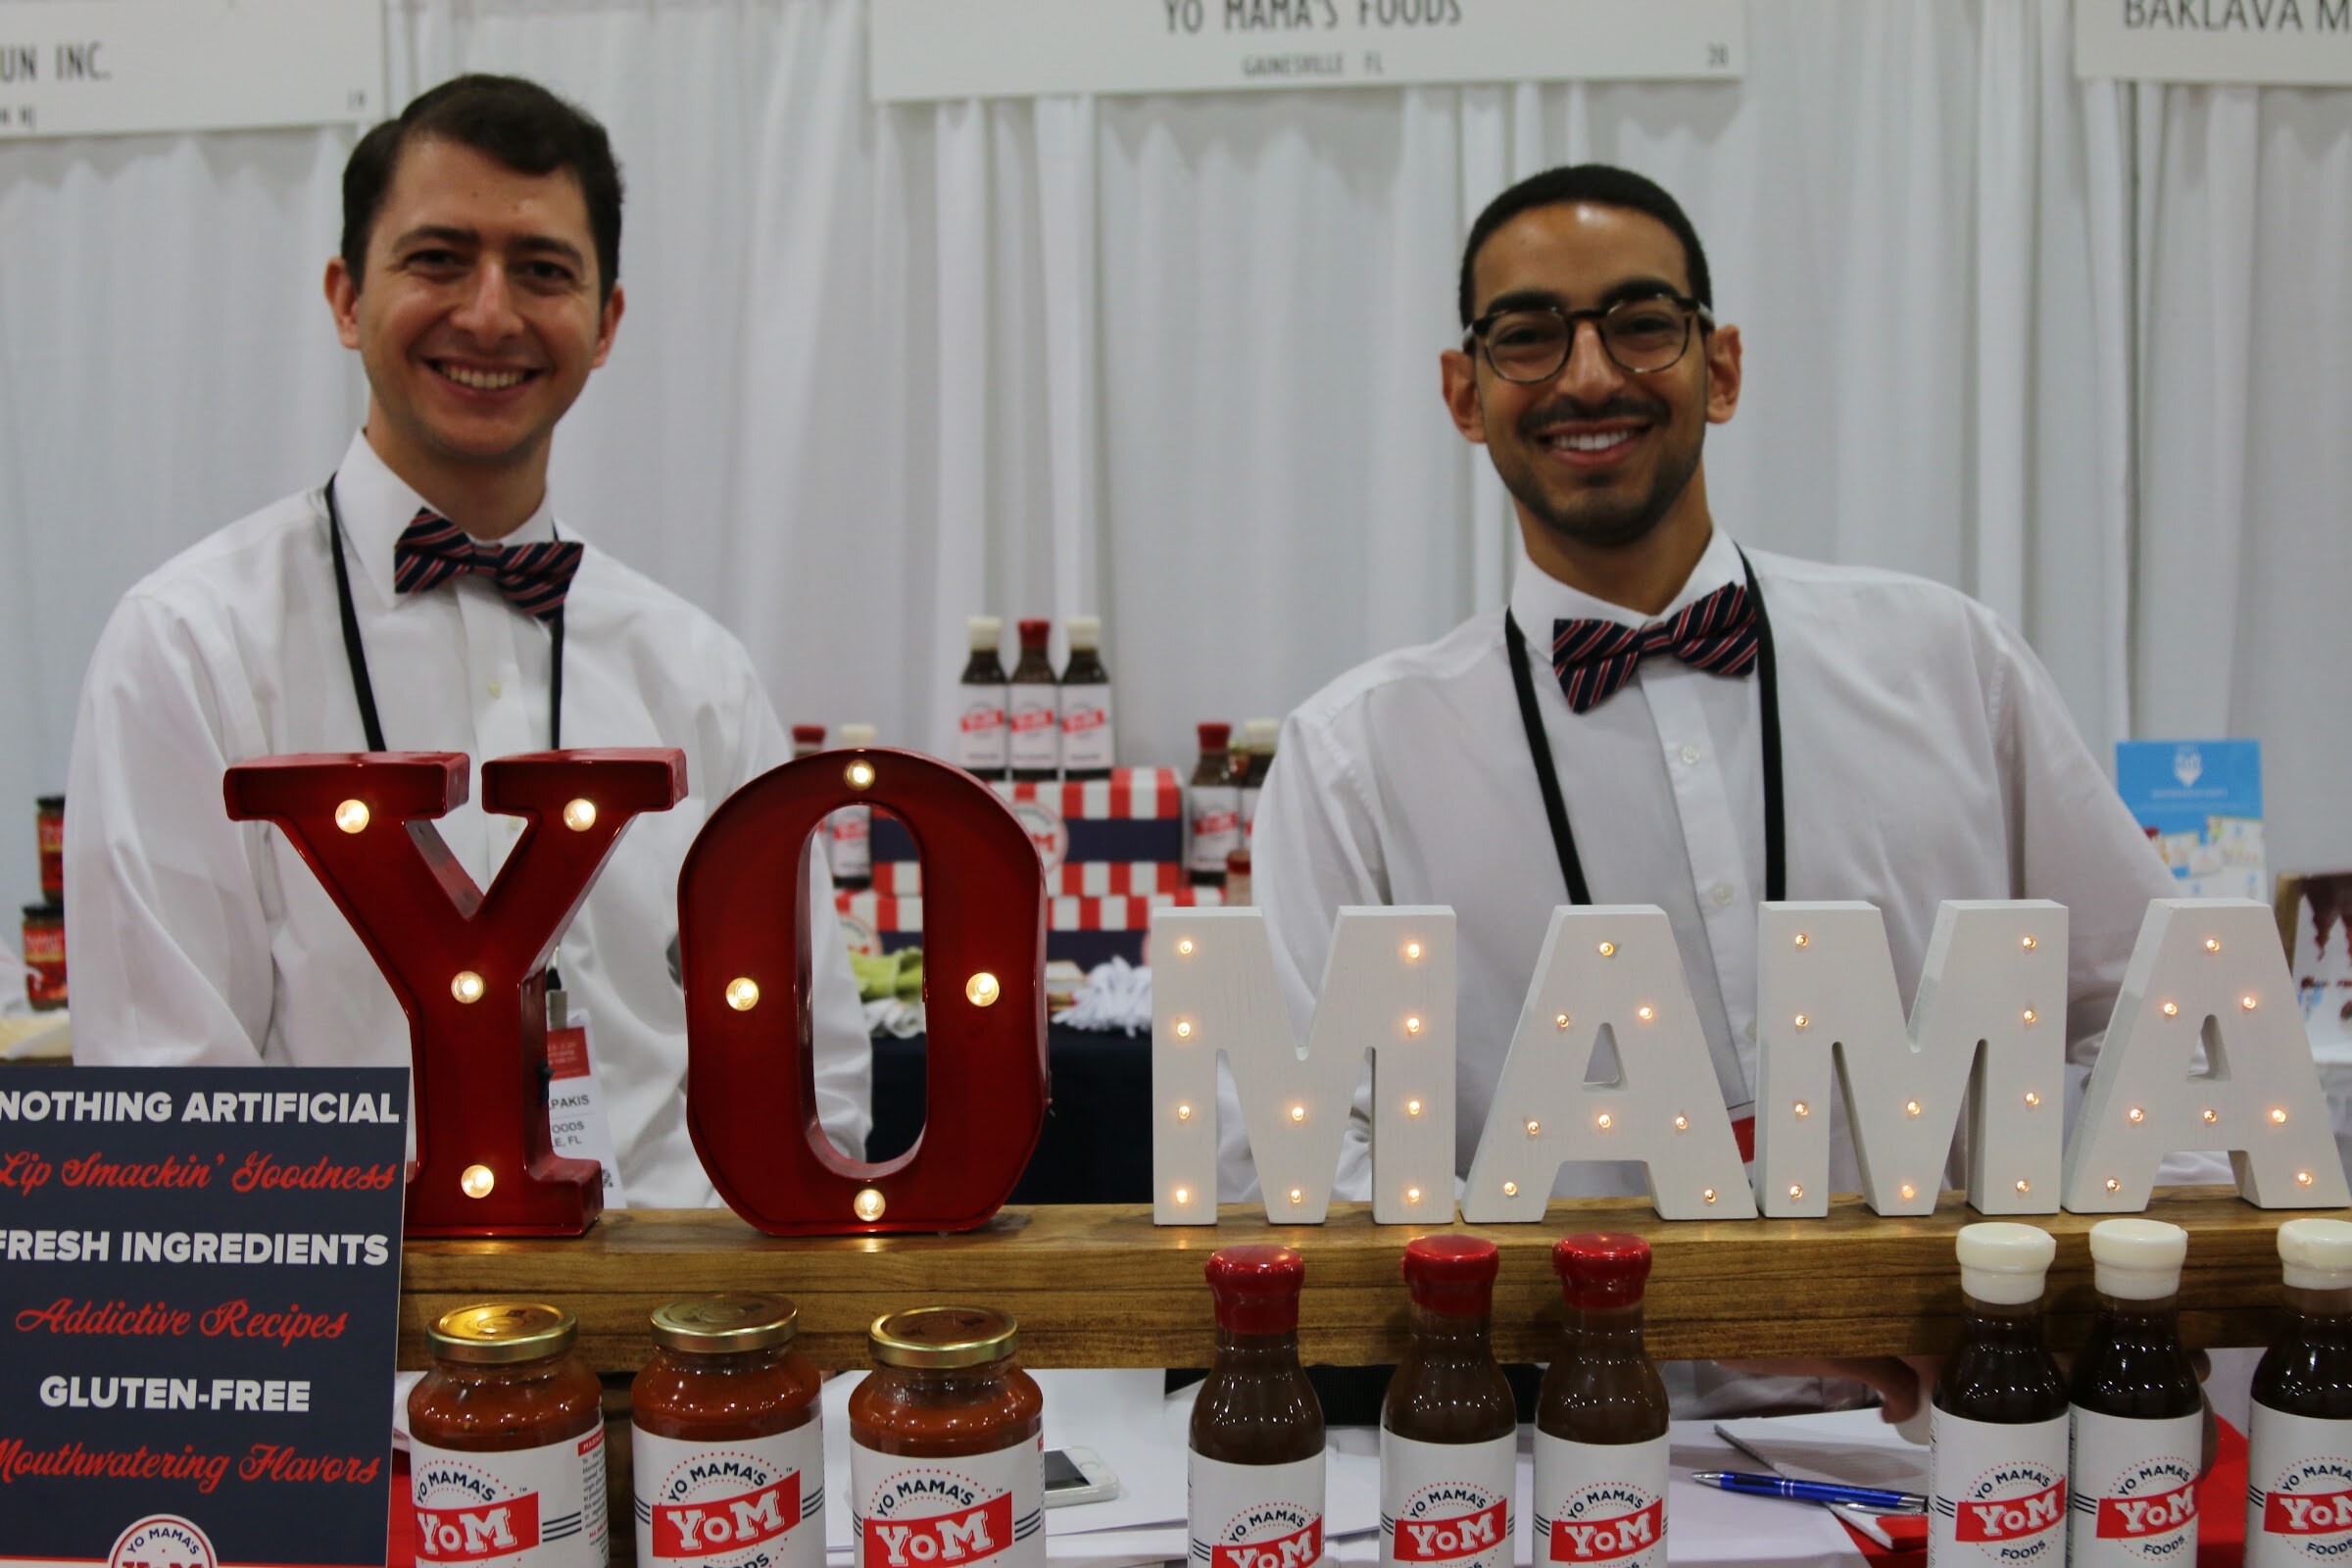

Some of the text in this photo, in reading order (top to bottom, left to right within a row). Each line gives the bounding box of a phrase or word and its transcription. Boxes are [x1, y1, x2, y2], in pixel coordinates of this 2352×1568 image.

[1165, 0, 1461, 33] YO MAMA'S FOODS
[2125, 0, 2303, 30] BAKLAVA
[56, 41, 112, 81] INC.
[1241, 51, 1384, 77] GAINESVILLE FL
[1152, 900, 2352, 1225] MAMA
[0, 1091, 400, 1124] NOTHING ARTIFICIAL
[550, 1095, 589, 1110] PAKIS
[0, 1151, 398, 1197] Lip Smackin' Goodness
[122, 1232, 389, 1266] INGREDIENTS
[15, 1298, 348, 1347] Addictive Recipes
[39, 1376, 311, 1412] GLUTEN-FREE
[238, 1444, 381, 1485] Flavors
[668, 1462, 767, 1501] YO MAMA'S
[2118, 1464, 2190, 1495] YO MAMA'S
[417, 1471, 496, 1503] YO MAMA'S
[877, 1480, 974, 1517] YO MAMA'S
[1975, 1469, 2050, 1499] YO MAMA'S
[2282, 1475, 2300, 1492] YO
[666, 1489, 785, 1550] YoM
[1409, 1489, 1487, 1518] YO MAMA'S
[1568, 1490, 1643, 1519] YO MAMA'S
[1972, 1490, 2058, 1537] YoM
[2114, 1485, 2195, 1534] YoM
[126, 1528, 200, 1555] YO MAMA'S
[416, 1506, 518, 1555] YoM
[875, 1509, 994, 1567] YoM
[1229, 1510, 1305, 1544] YO MAMA'S
[1406, 1512, 1496, 1556] YoM
[1564, 1512, 1653, 1557] YoM
